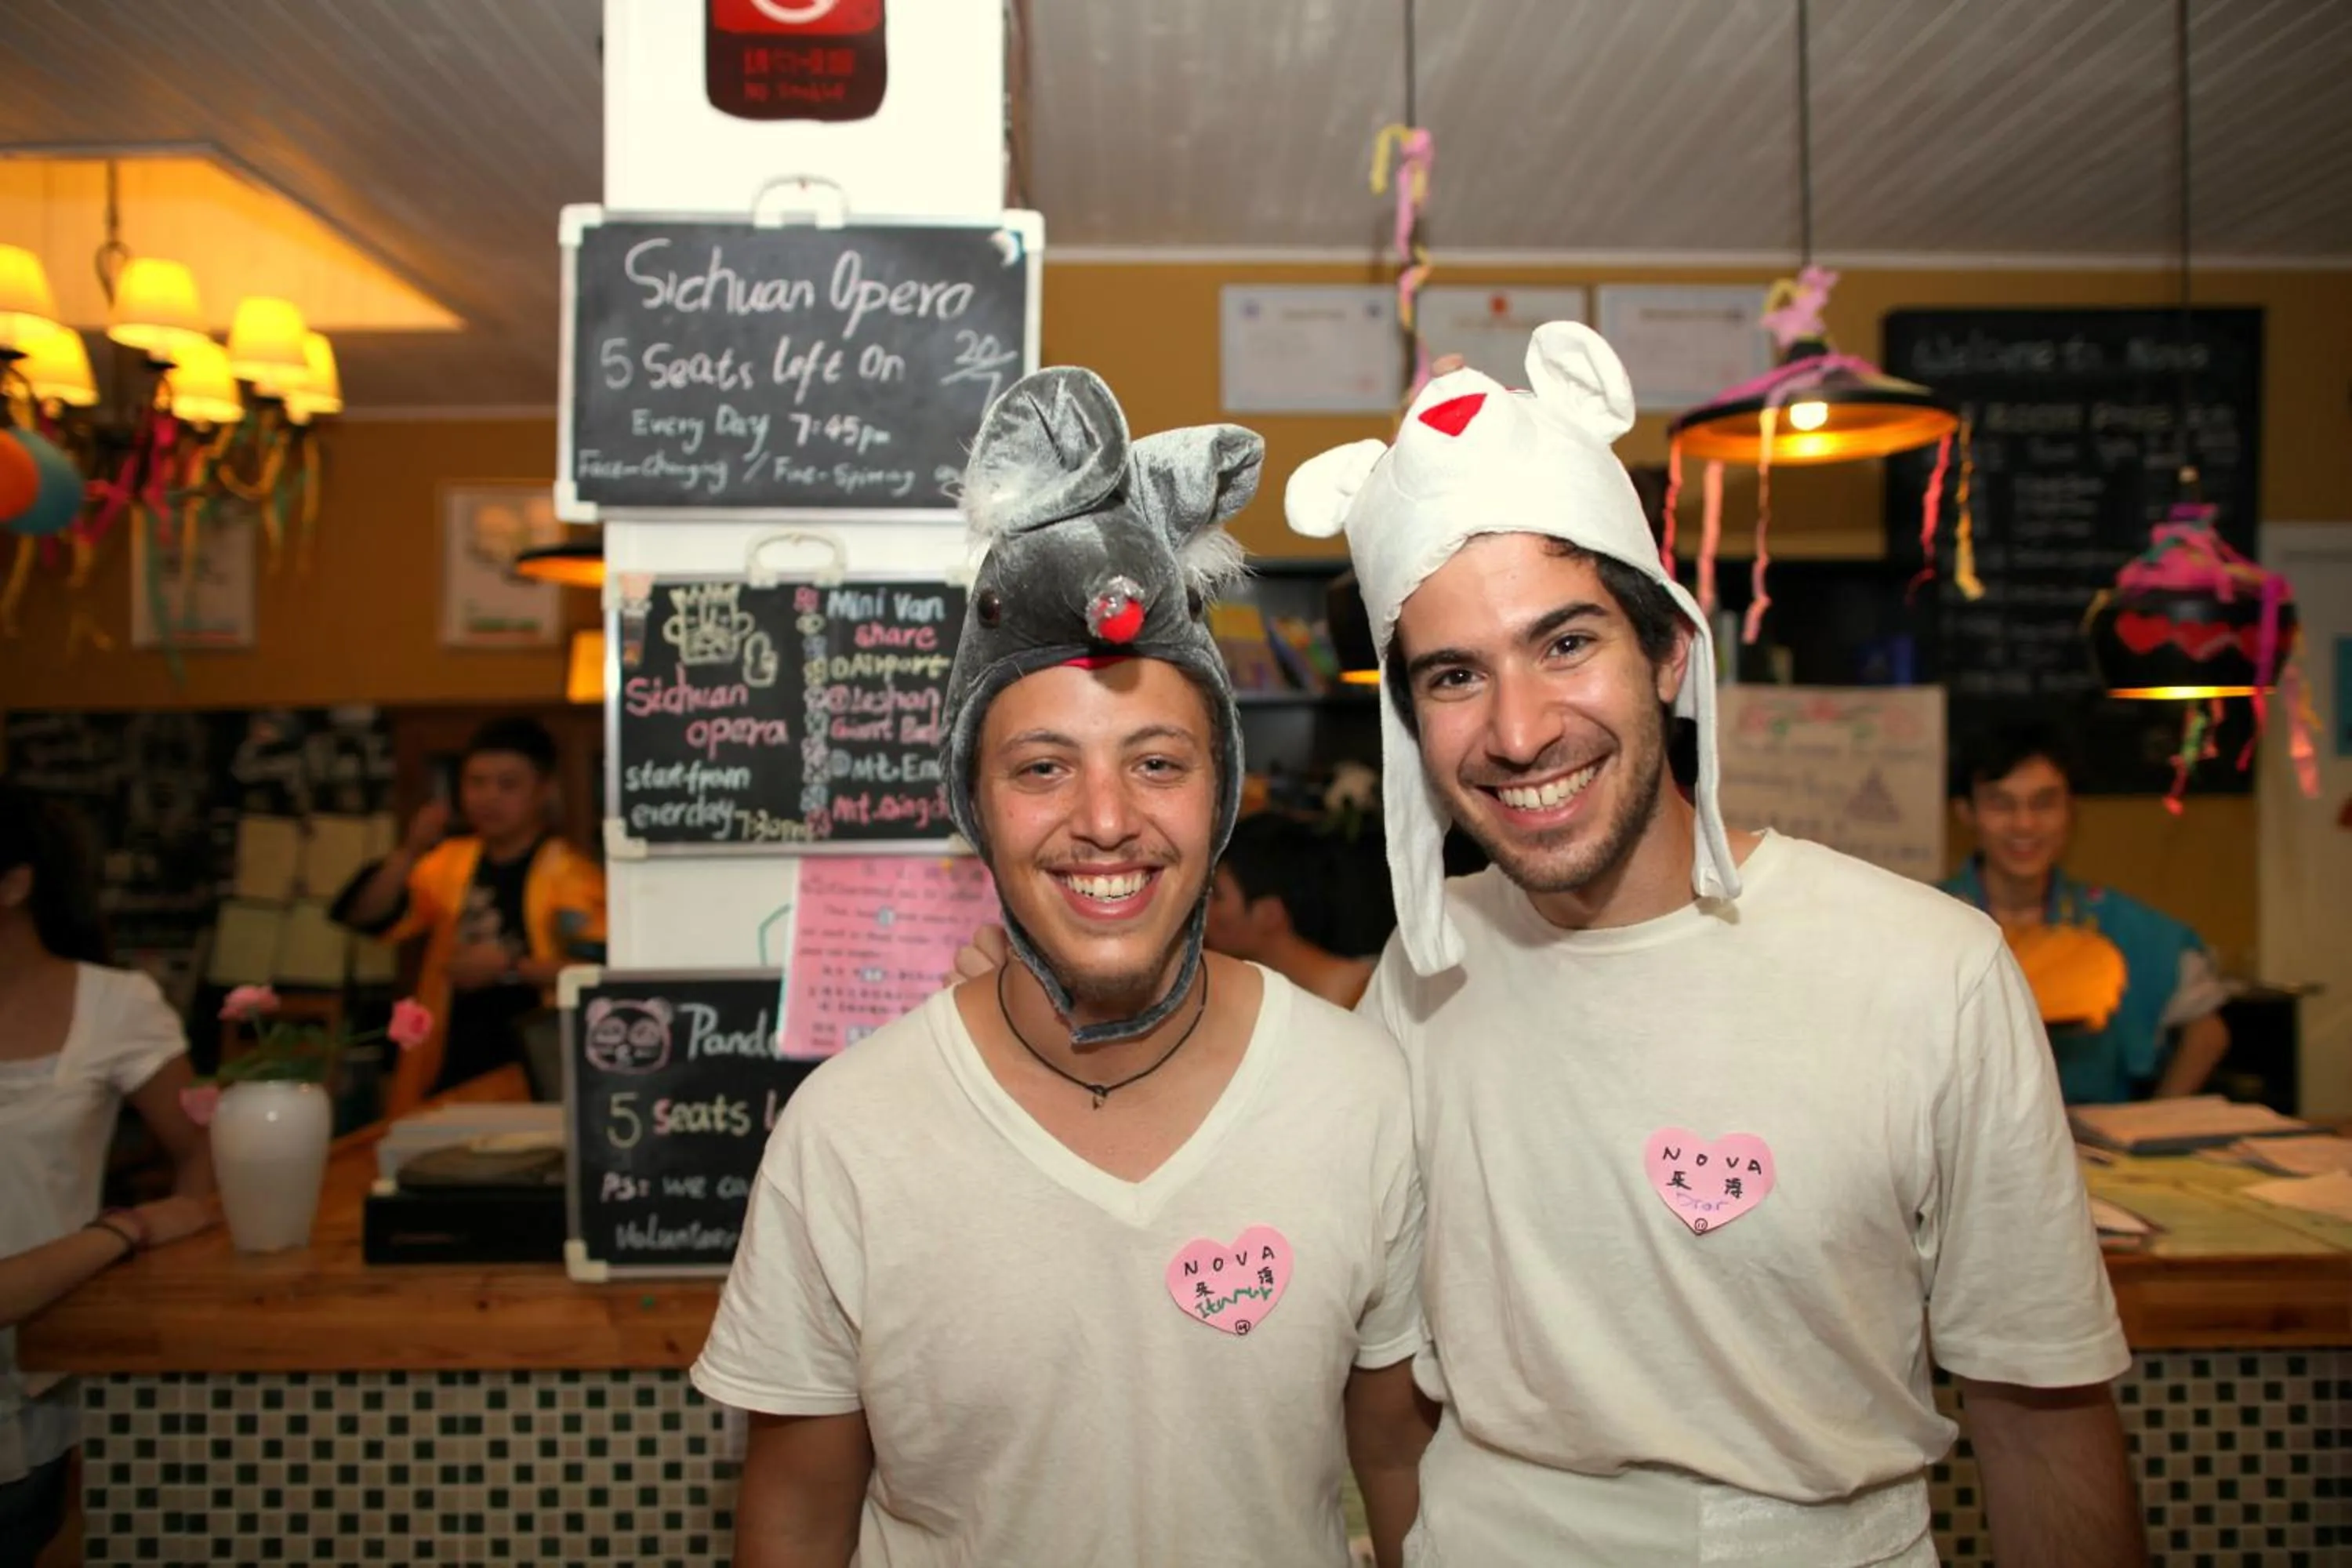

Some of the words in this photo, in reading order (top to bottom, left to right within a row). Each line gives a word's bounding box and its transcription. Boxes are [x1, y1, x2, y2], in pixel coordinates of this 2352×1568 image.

[625, 238, 814, 315] Sichuan
[830, 250, 975, 339] Opera
[601, 337, 633, 388] 5
[643, 343, 753, 390] Seats
[632, 408, 704, 454] Every
[715, 405, 771, 462] Day
[827, 587, 886, 619] Mini
[894, 593, 946, 622] Van
[855, 621, 938, 651] share
[626, 663, 748, 717] Sichuan
[687, 717, 789, 761] opera
[606, 1093, 642, 1148] 5
[1662, 1147, 1762, 1174] NOVA
[1184, 1246, 1275, 1276] NOVA
